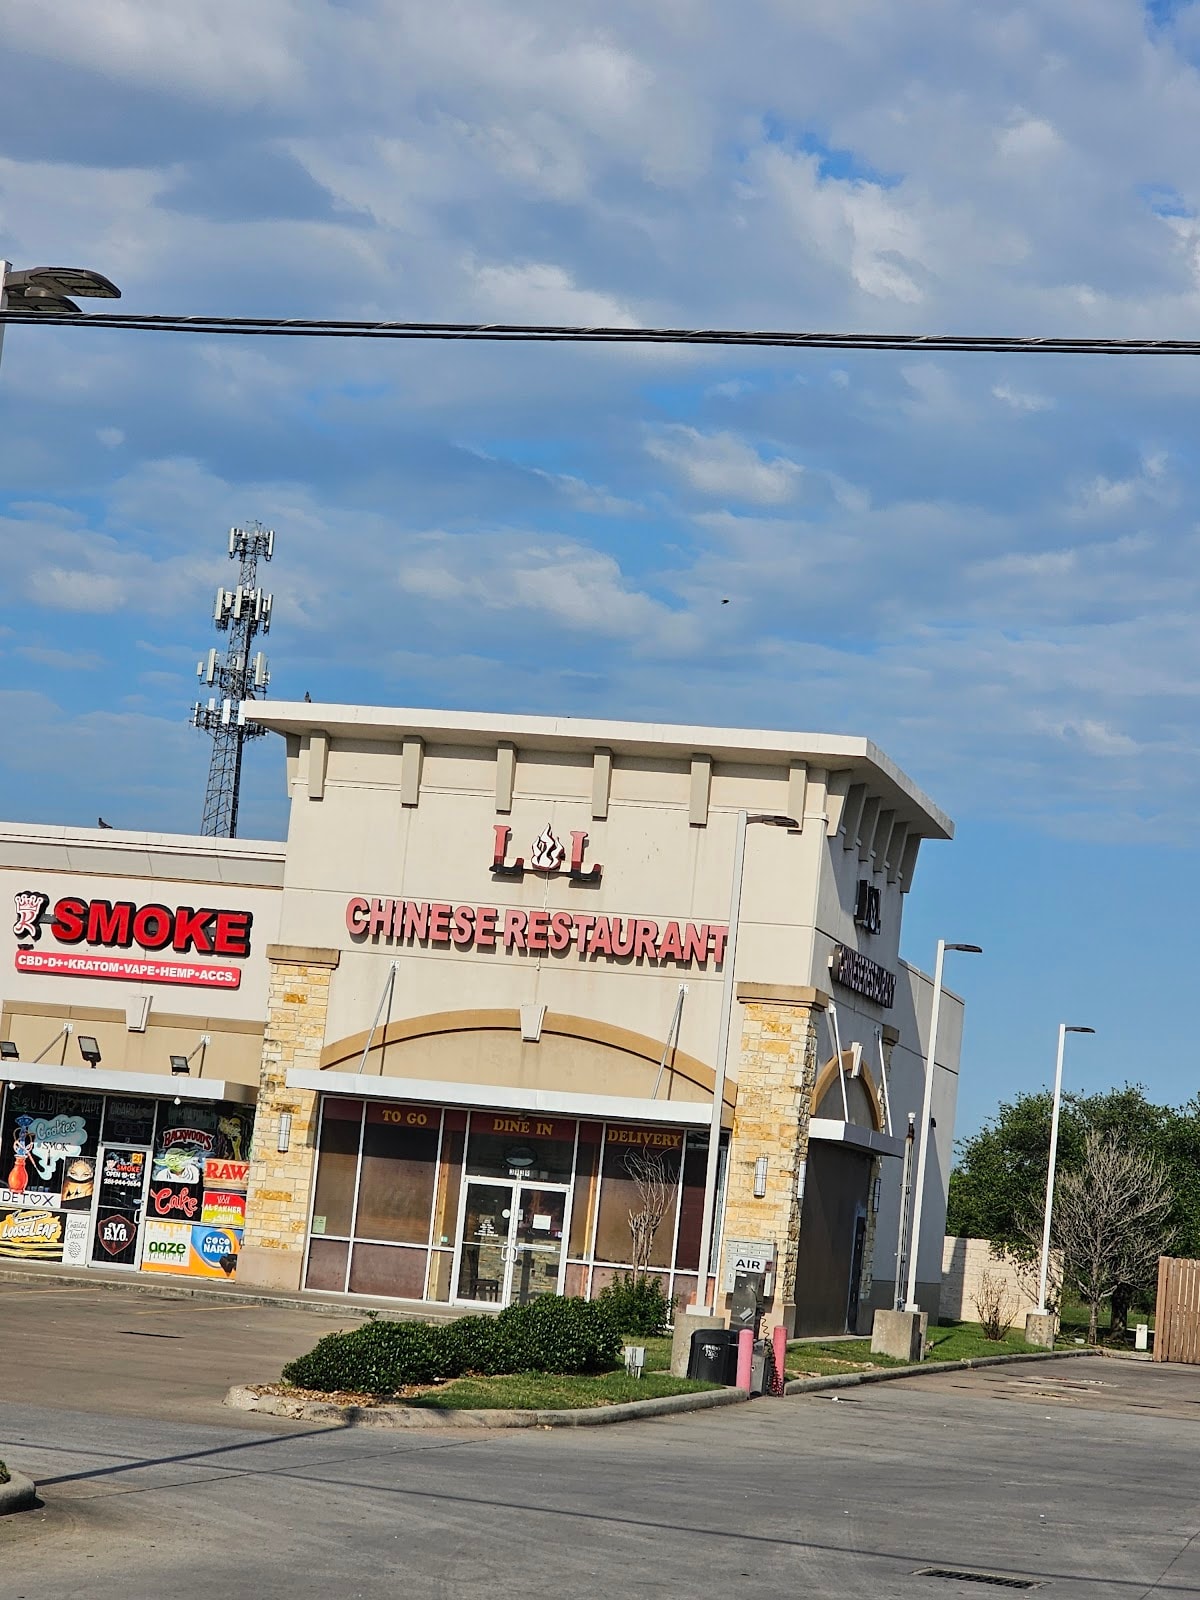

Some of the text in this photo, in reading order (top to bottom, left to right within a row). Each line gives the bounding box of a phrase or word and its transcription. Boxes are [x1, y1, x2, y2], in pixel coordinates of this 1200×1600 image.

[50, 899, 251, 956] SMOKE
[346, 897, 729, 964] CHINESE RESTAURANT
[382, 1110, 427, 1125] TO GO
[36, 1120, 77, 1140] Cookies
[493, 1118, 554, 1136] DINE IN
[164, 1129, 212, 1150] BACKWOODS
[608, 1129, 682, 1148] DELIVERY
[116, 1164, 141, 1173] SMOKE
[206, 1162, 249, 1180] RAW
[151, 1187, 198, 1217] Cake
[148, 1241, 187, 1254] ooze
[203, 1244, 231, 1254] NARA
[205, 1236, 230, 1246] COCO
[735, 1258, 762, 1270] AIR
